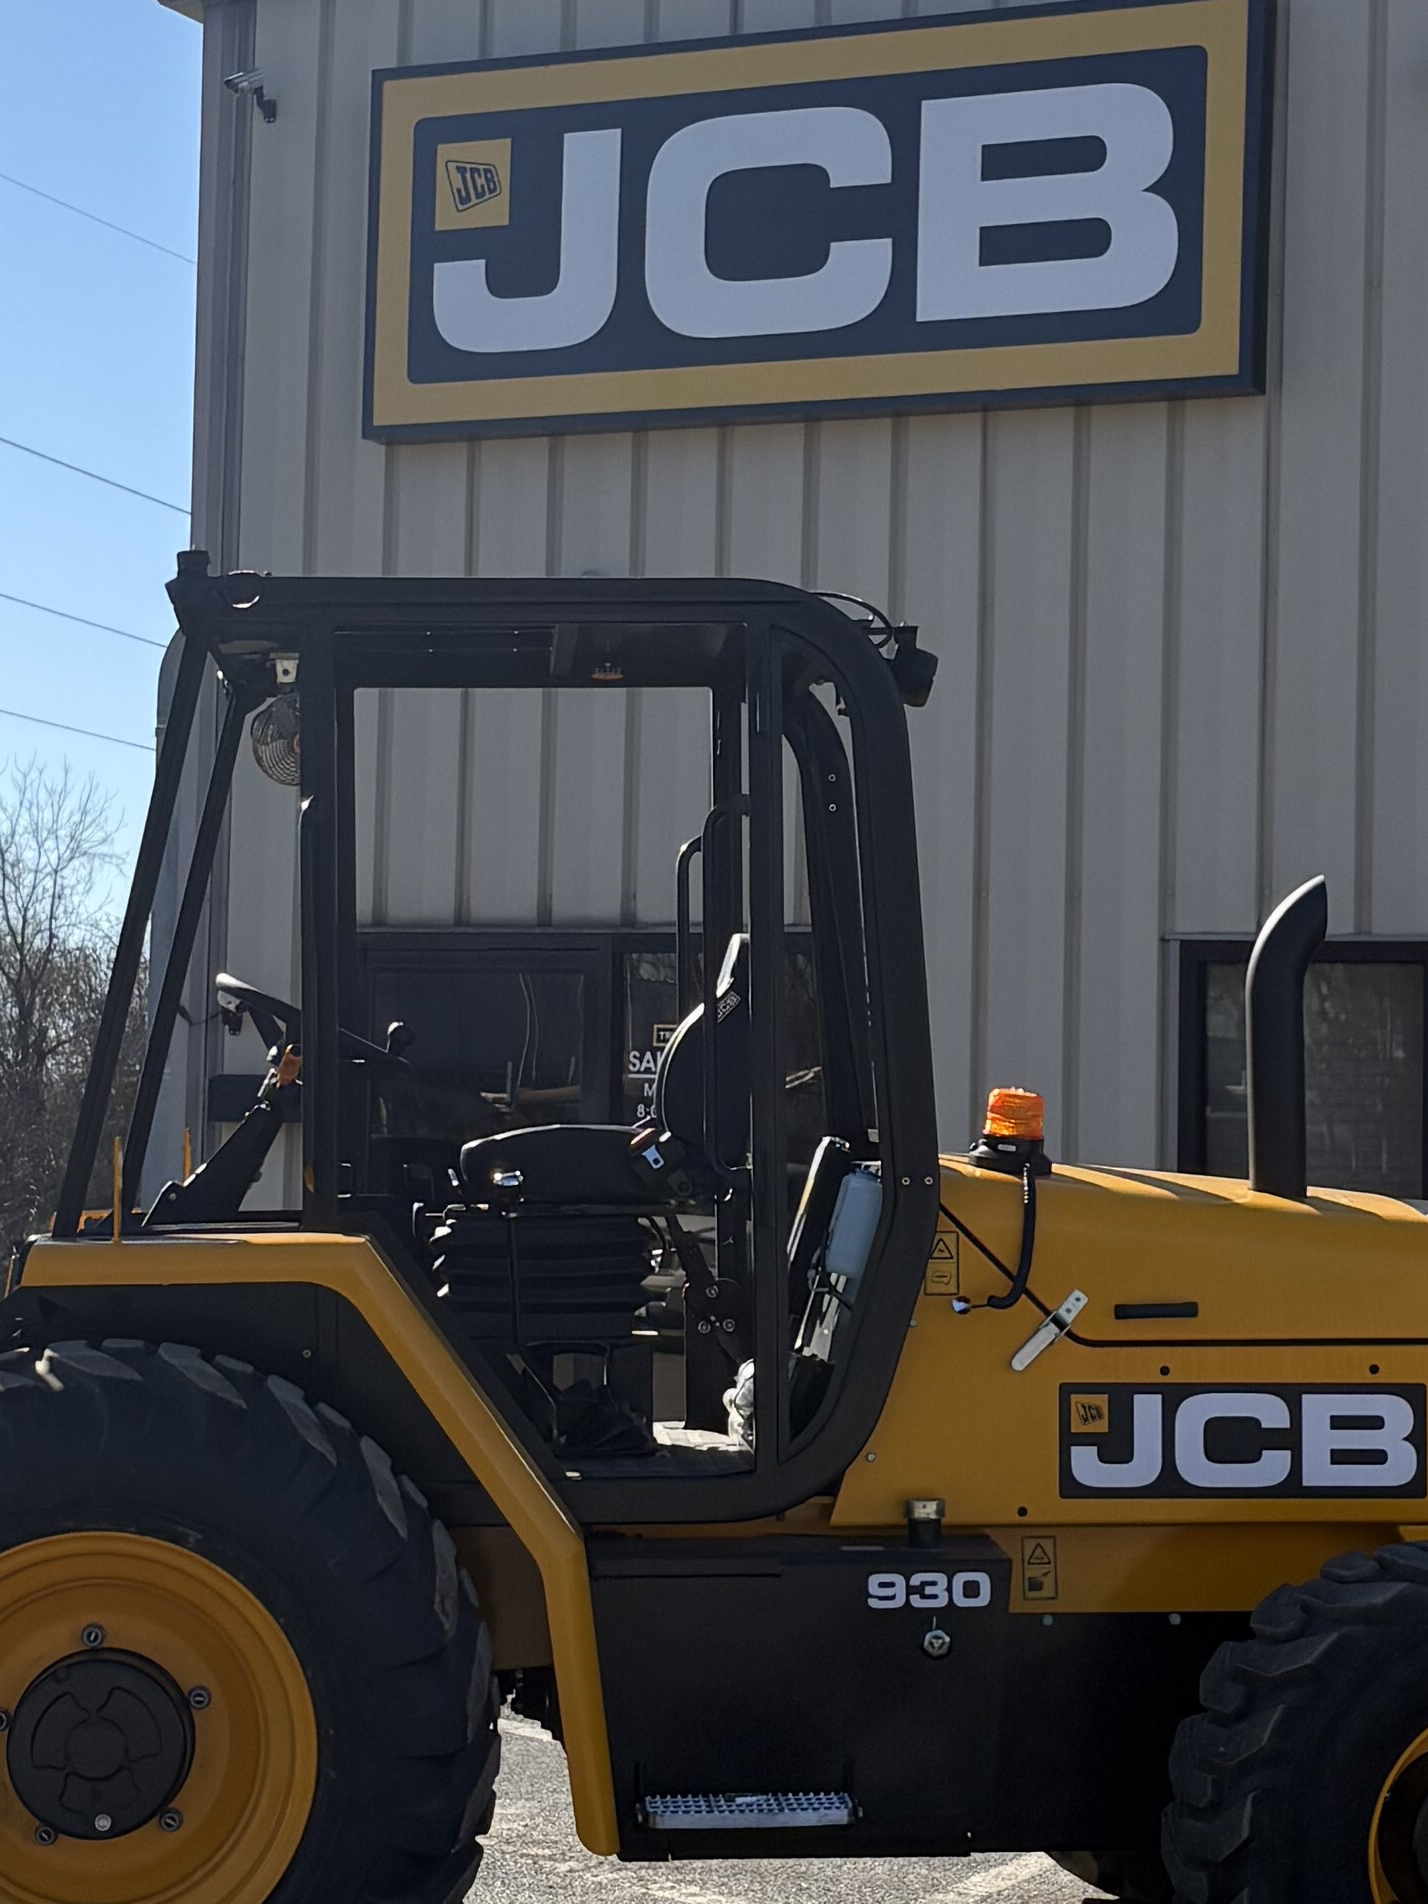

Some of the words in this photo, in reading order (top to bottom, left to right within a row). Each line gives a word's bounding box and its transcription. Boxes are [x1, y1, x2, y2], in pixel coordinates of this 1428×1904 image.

[433, 82, 1180, 354] JCB
[455, 164, 499, 206] JCB
[1070, 1392, 1419, 1489] JCB
[867, 1571, 992, 1609] 930
